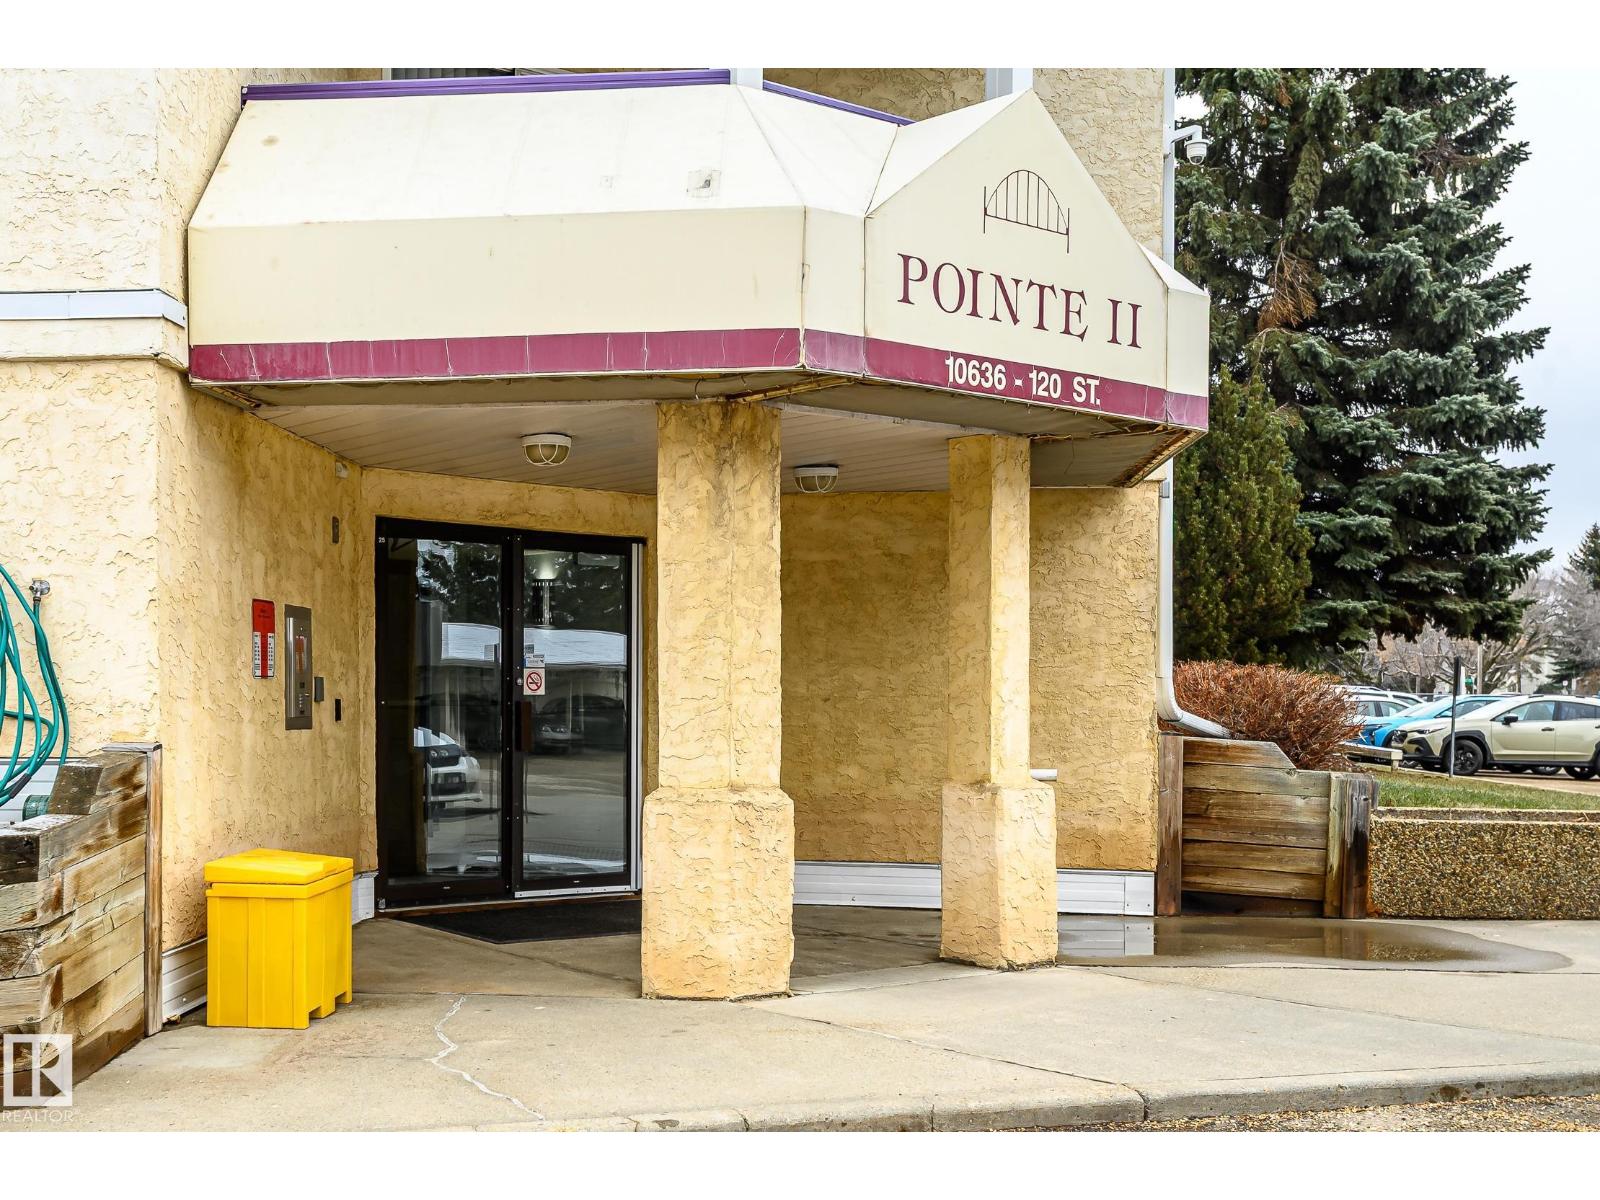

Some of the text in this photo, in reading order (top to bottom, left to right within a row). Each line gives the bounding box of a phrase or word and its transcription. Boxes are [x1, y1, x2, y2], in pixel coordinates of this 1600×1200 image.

[897, 253, 1142, 349] POINTE II
[945, 356, 1007, 390] 10636
[1029, 369, 1062, 399] 120
[1072, 376, 1101, 405] ST.
